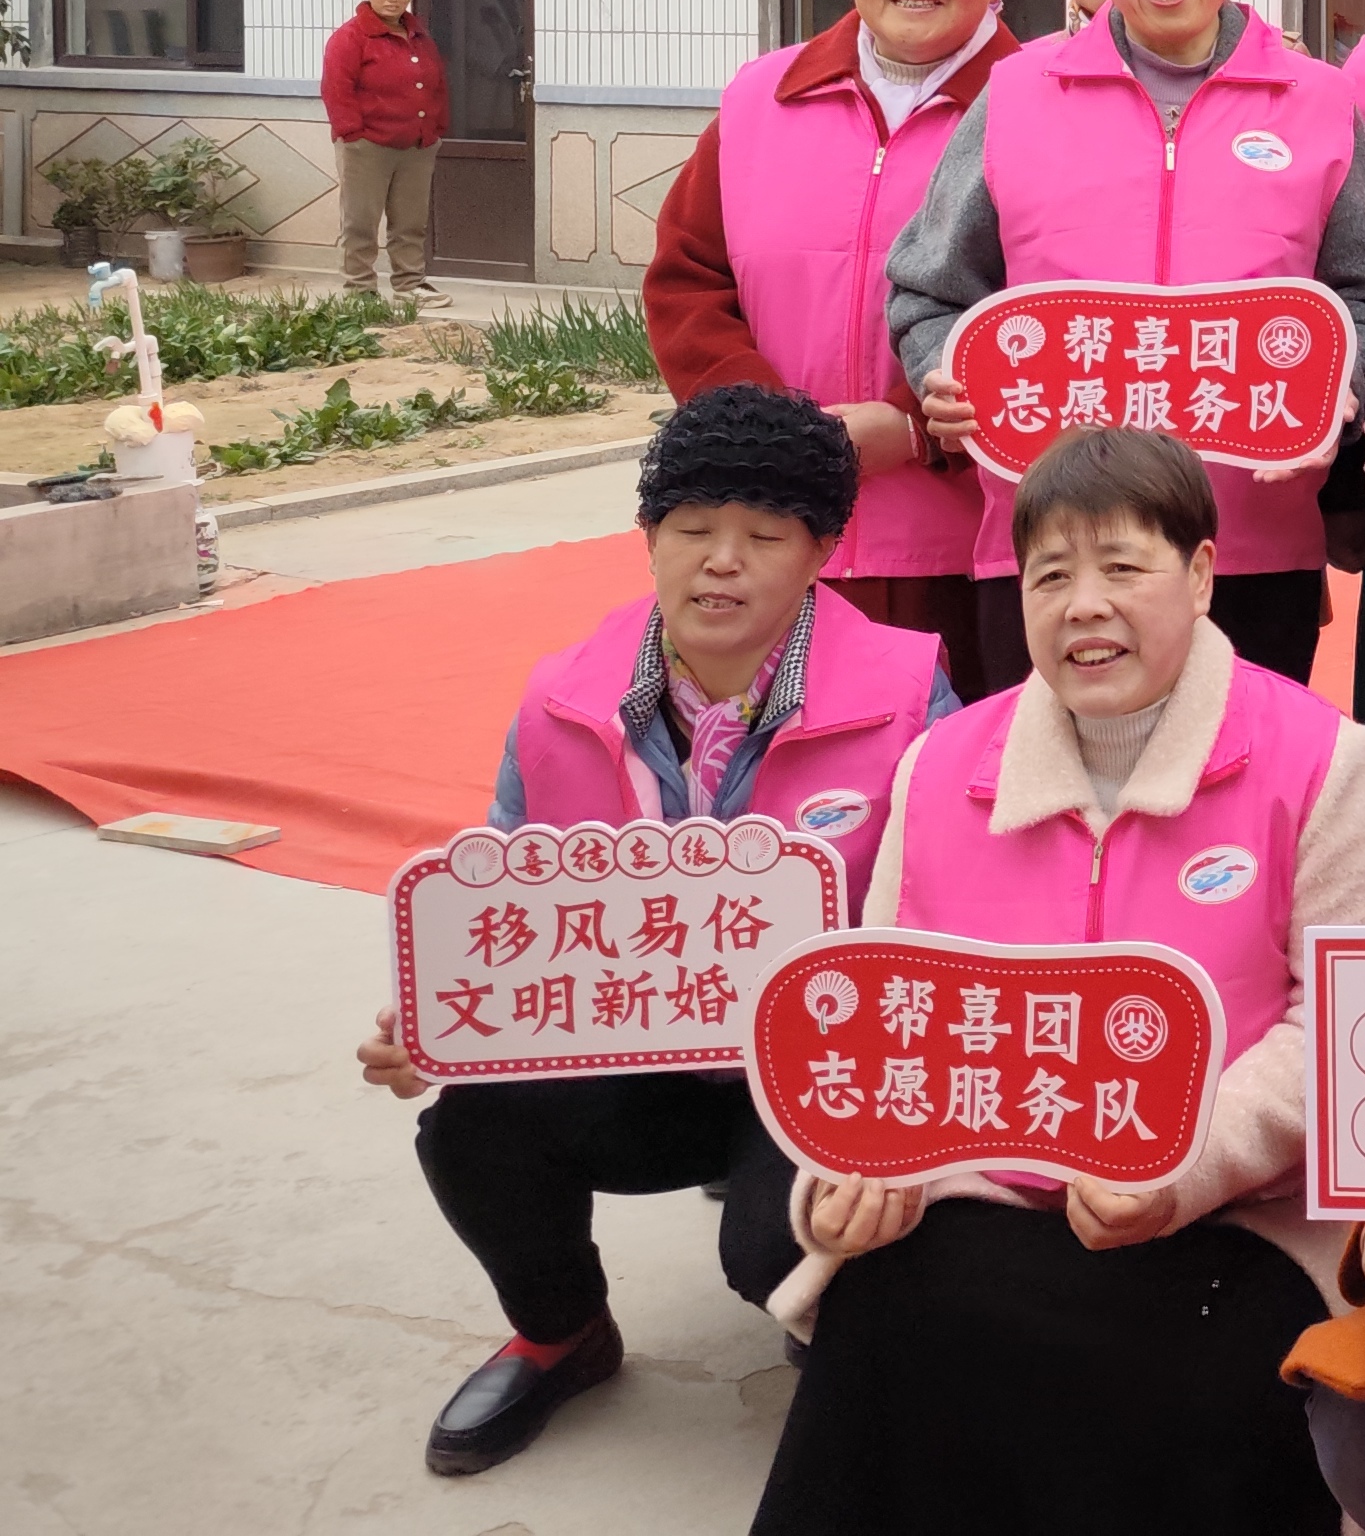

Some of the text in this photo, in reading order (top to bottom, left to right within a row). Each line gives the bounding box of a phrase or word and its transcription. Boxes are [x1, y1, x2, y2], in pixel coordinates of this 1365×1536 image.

[1063, 314, 1240, 375] 帮喜团
[991, 377, 1304, 433] 志愿服务队
[465, 893, 775, 968] 移风易俗
[435, 962, 739, 1041] 文明新婚
[878, 975, 1083, 1064] 帮喜团
[798, 1049, 1159, 1143] 志愿服务队
